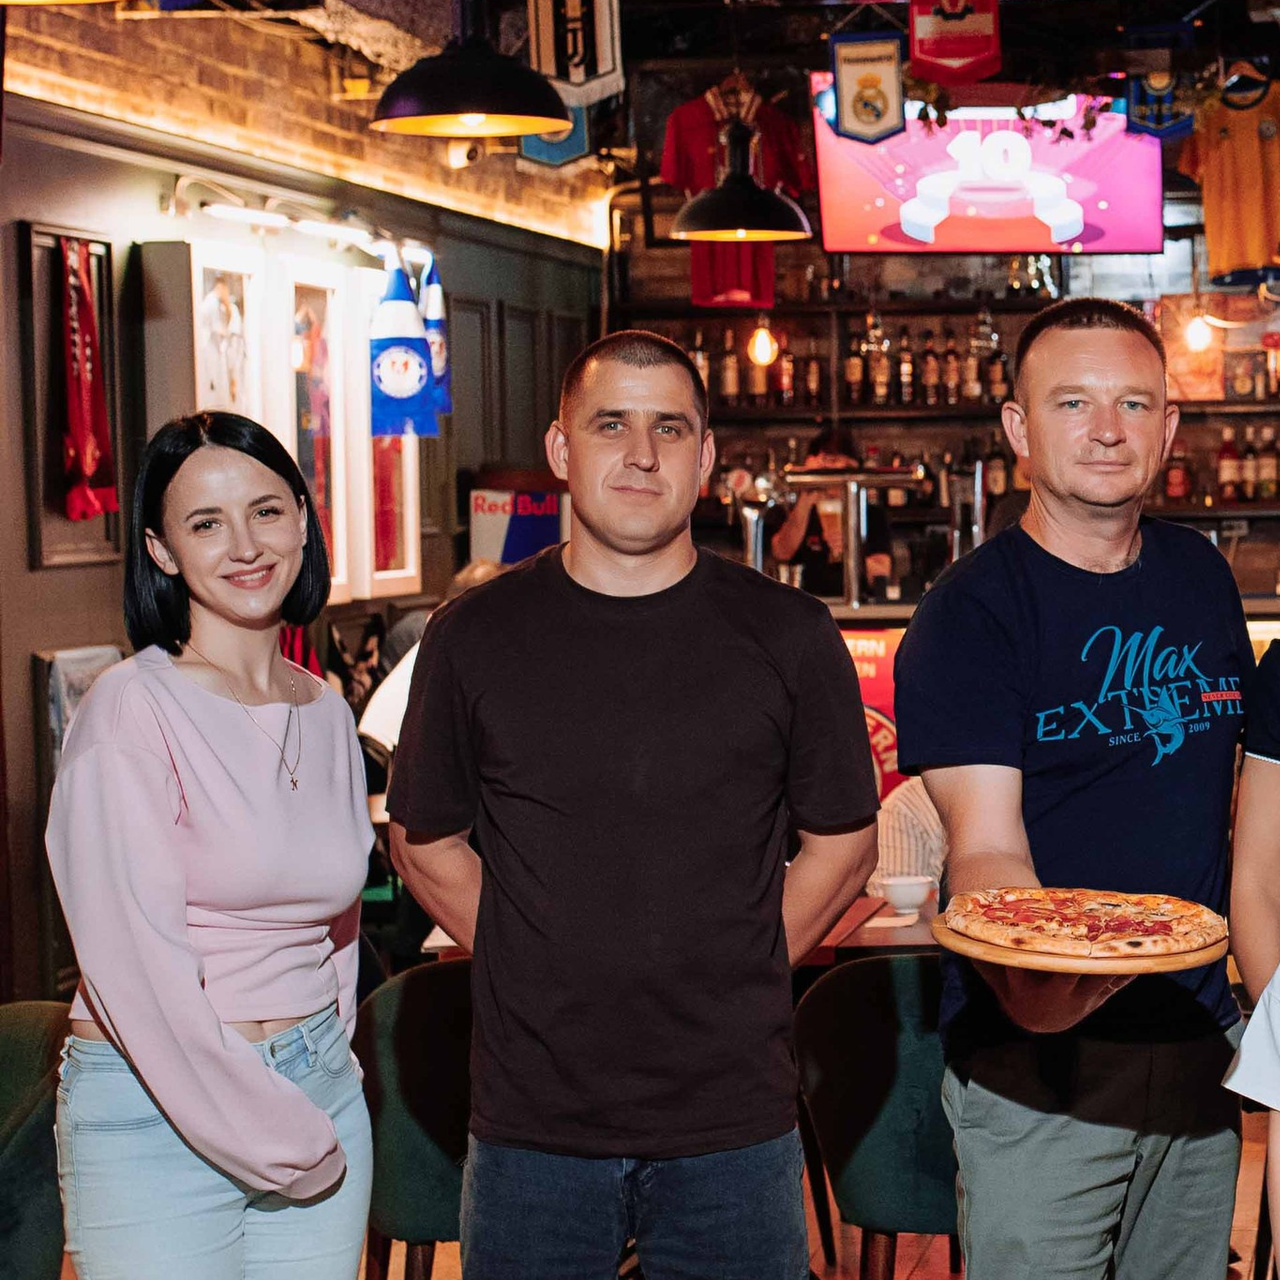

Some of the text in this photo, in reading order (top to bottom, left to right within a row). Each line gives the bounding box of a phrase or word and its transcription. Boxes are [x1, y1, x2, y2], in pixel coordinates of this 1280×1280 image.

[946, 130, 1032, 179] 10
[473, 493, 558, 516] Red Bull
[1081, 625, 1213, 704] Max
[1108, 721, 1211, 747] SINCE 2009
